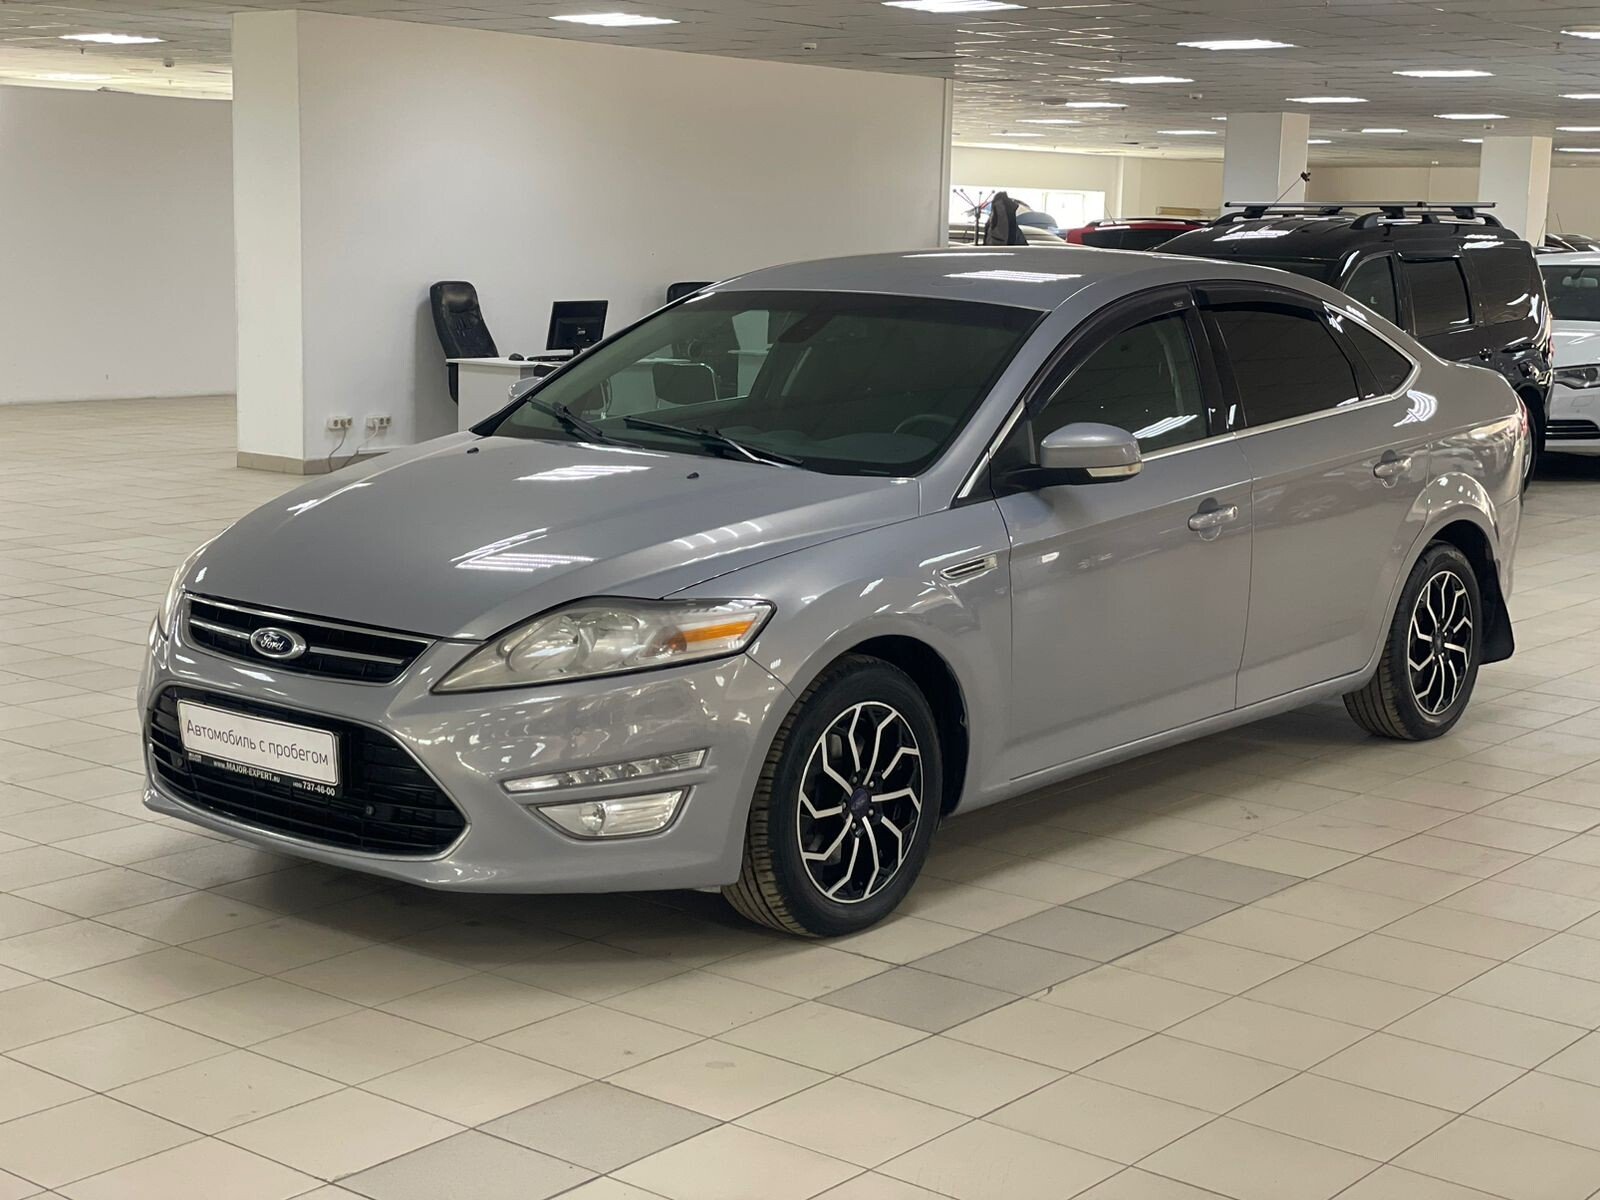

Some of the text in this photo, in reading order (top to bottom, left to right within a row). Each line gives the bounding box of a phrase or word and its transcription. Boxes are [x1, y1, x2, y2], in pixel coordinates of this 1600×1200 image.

[260, 633, 285, 650] Ford
[187, 719, 329, 766] Автомобиль с пробегом
